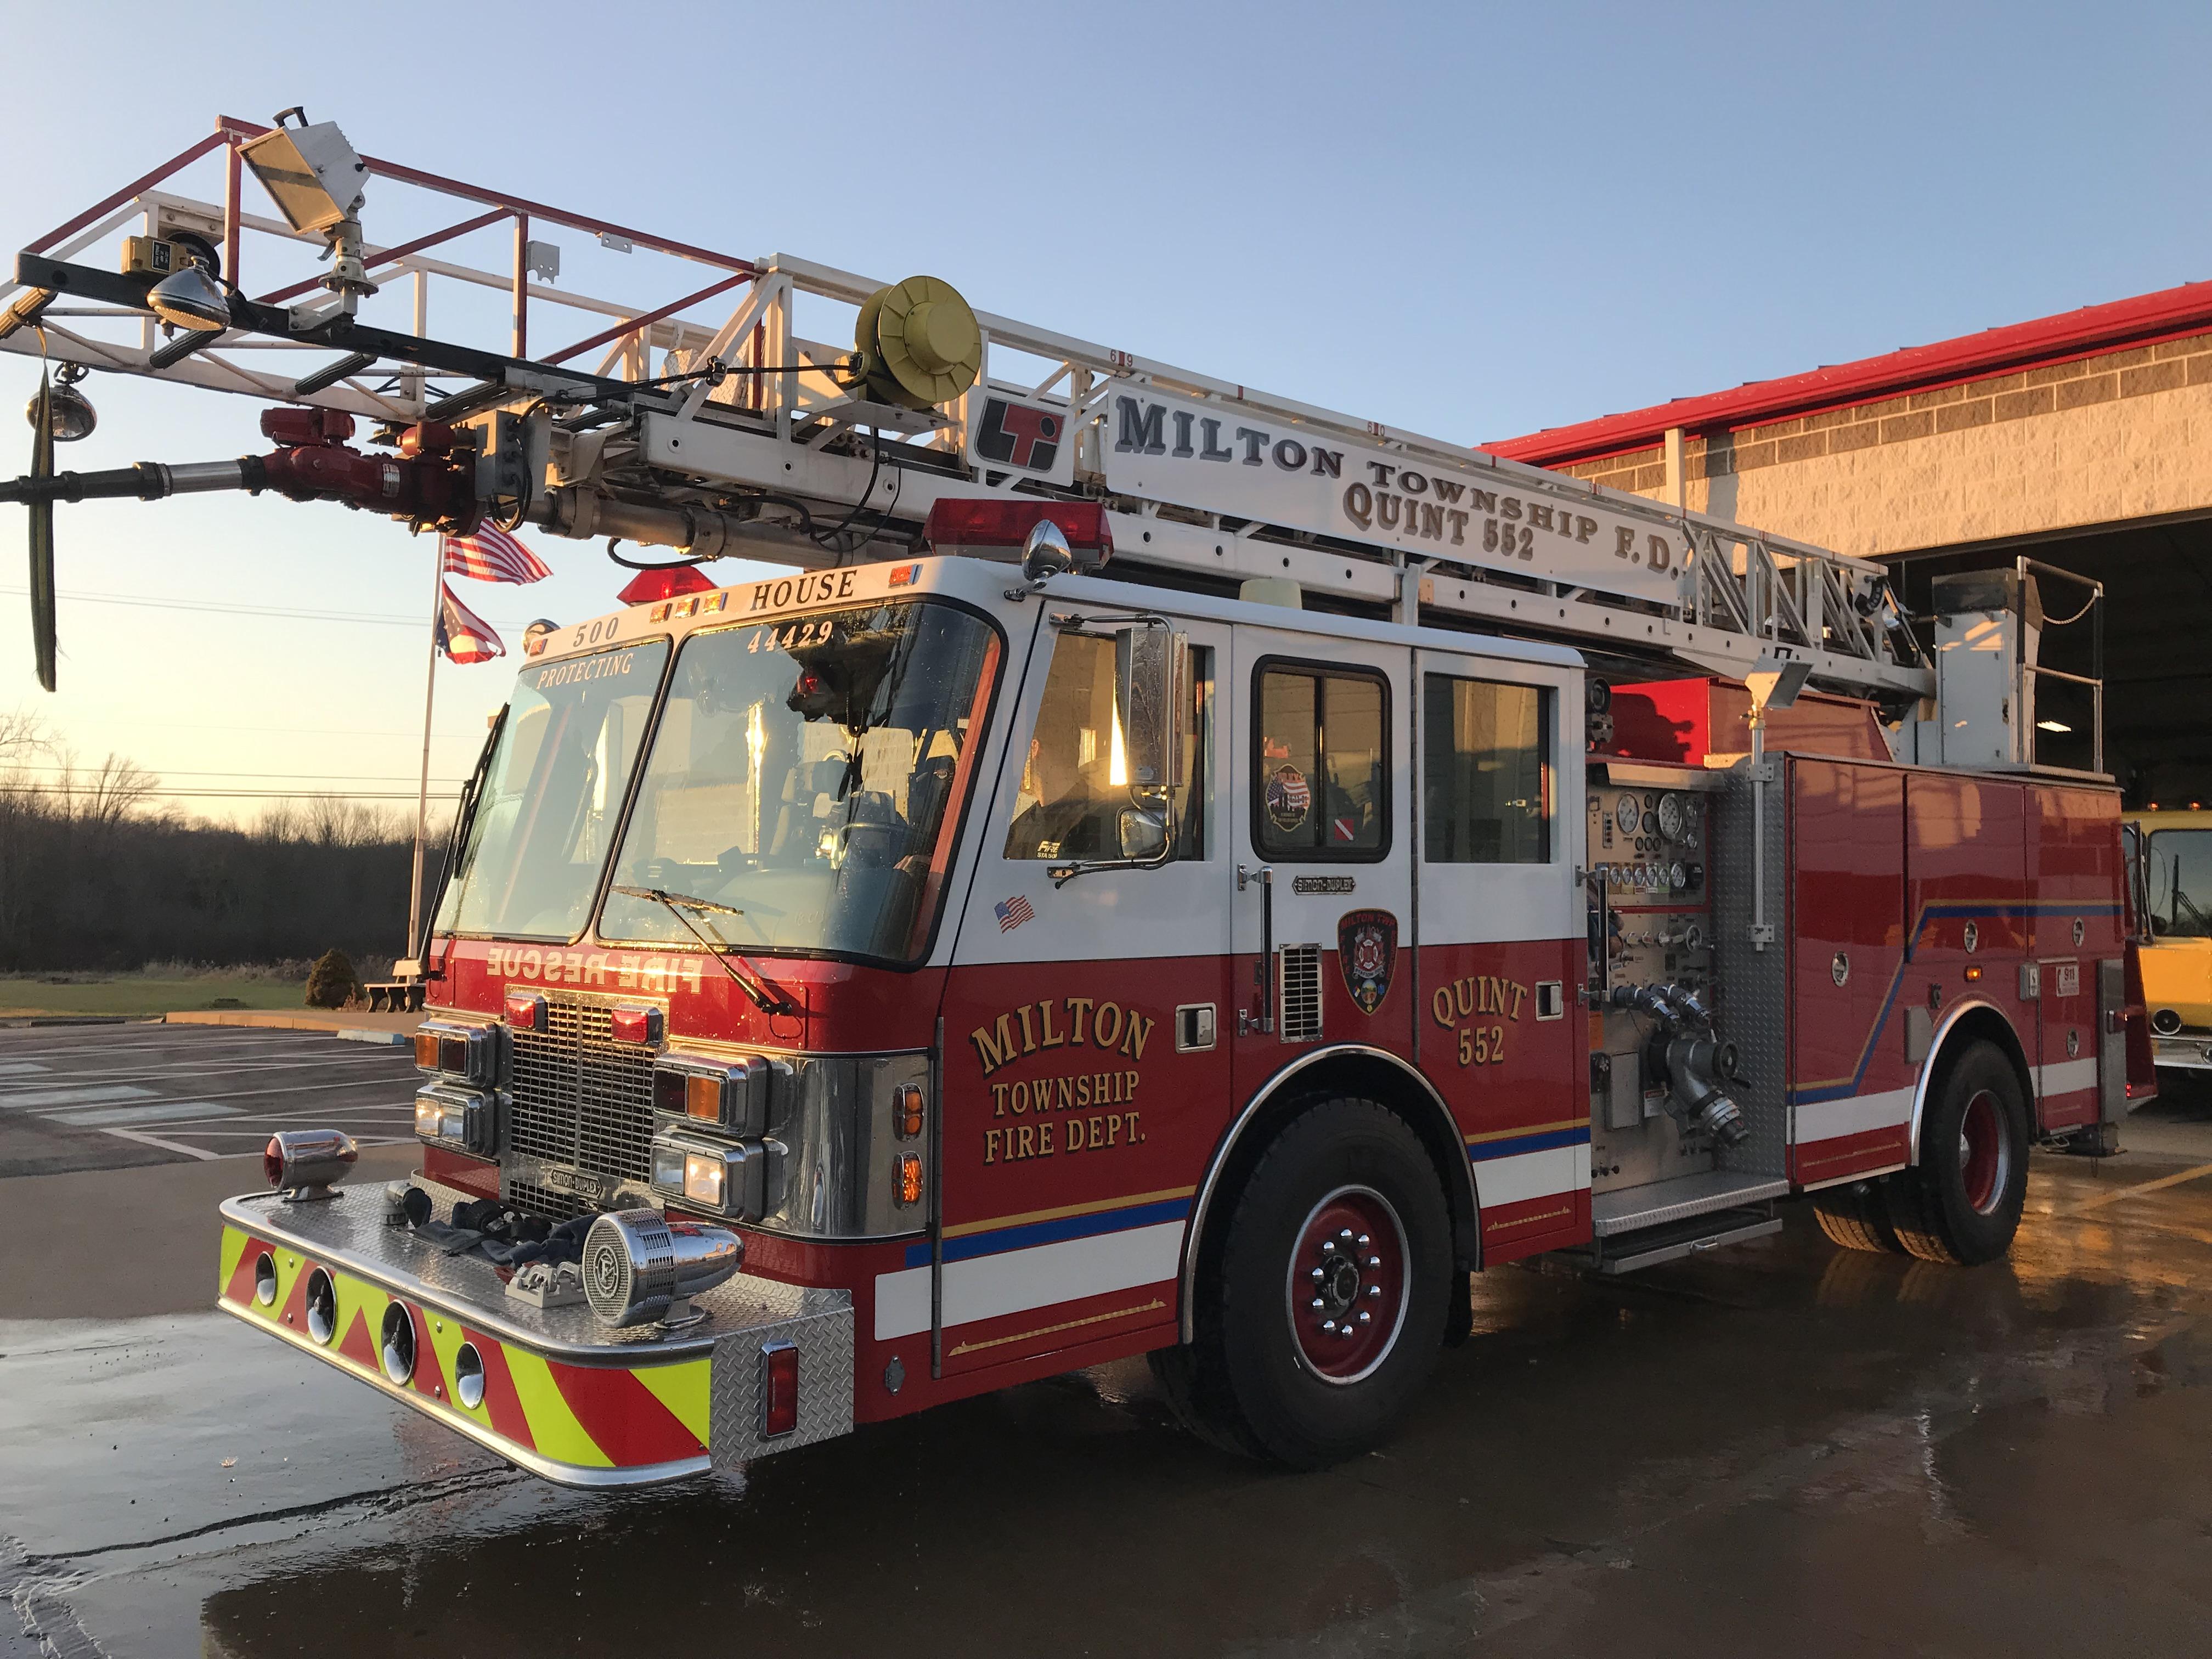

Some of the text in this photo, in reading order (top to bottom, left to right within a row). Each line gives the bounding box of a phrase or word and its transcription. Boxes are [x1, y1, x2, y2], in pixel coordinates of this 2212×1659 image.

[1115, 395, 1679, 581] MILTON TOWNSHIP F.D.
[1343, 482, 1534, 562] QUINT 552
[573, 569, 857, 647] 500 HOUSE
[536, 621, 833, 690] PROTECTING 44429
[1431, 975, 1528, 1031] QUINT
[2064, 968, 2075, 981] 911
[969, 997, 1155, 1079] MILTON
[1458, 1025, 1504, 1068] 552
[990, 1070, 1141, 1119] TOWNSHIP
[983, 1111, 1147, 1167] FIRE DEPT.
